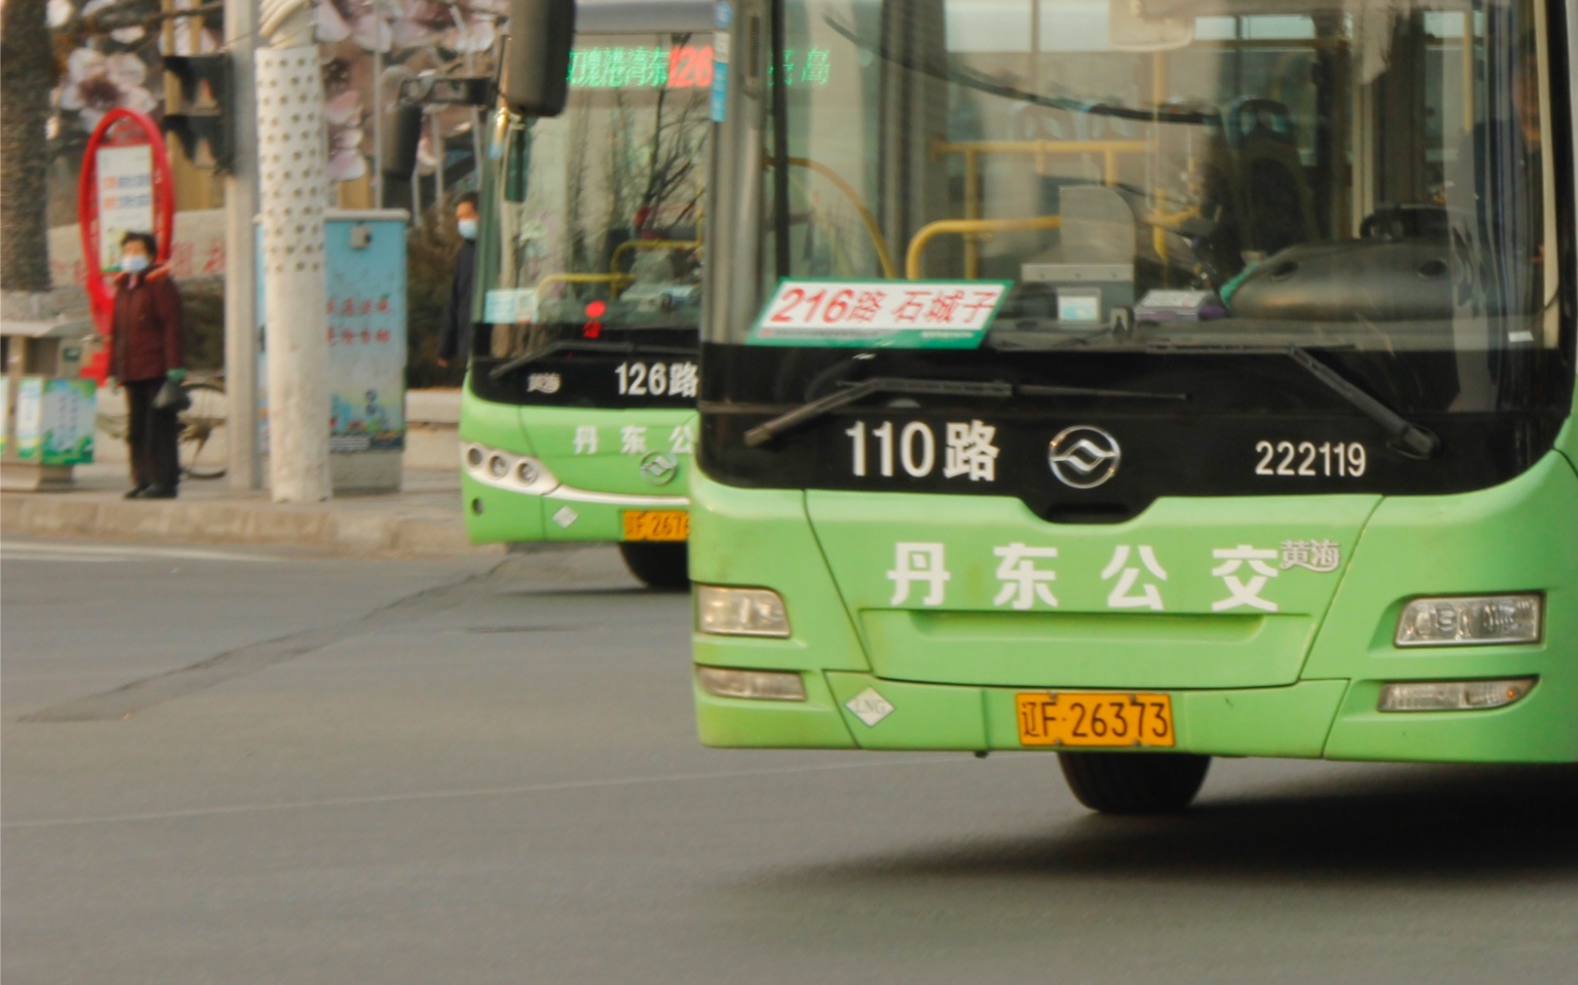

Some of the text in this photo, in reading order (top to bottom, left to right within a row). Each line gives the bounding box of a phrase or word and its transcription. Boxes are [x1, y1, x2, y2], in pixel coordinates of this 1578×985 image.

[667, 45, 714, 88] 126
[771, 288, 997, 324] 216路 石城子
[615, 361, 699, 398] 126路
[845, 420, 1000, 482] 110路
[1254, 440, 1367, 477] 222119
[1279, 539, 1341, 574] 黄海
[886, 542, 1279, 612] 丹东公交
[853, 697, 888, 715] LNG
